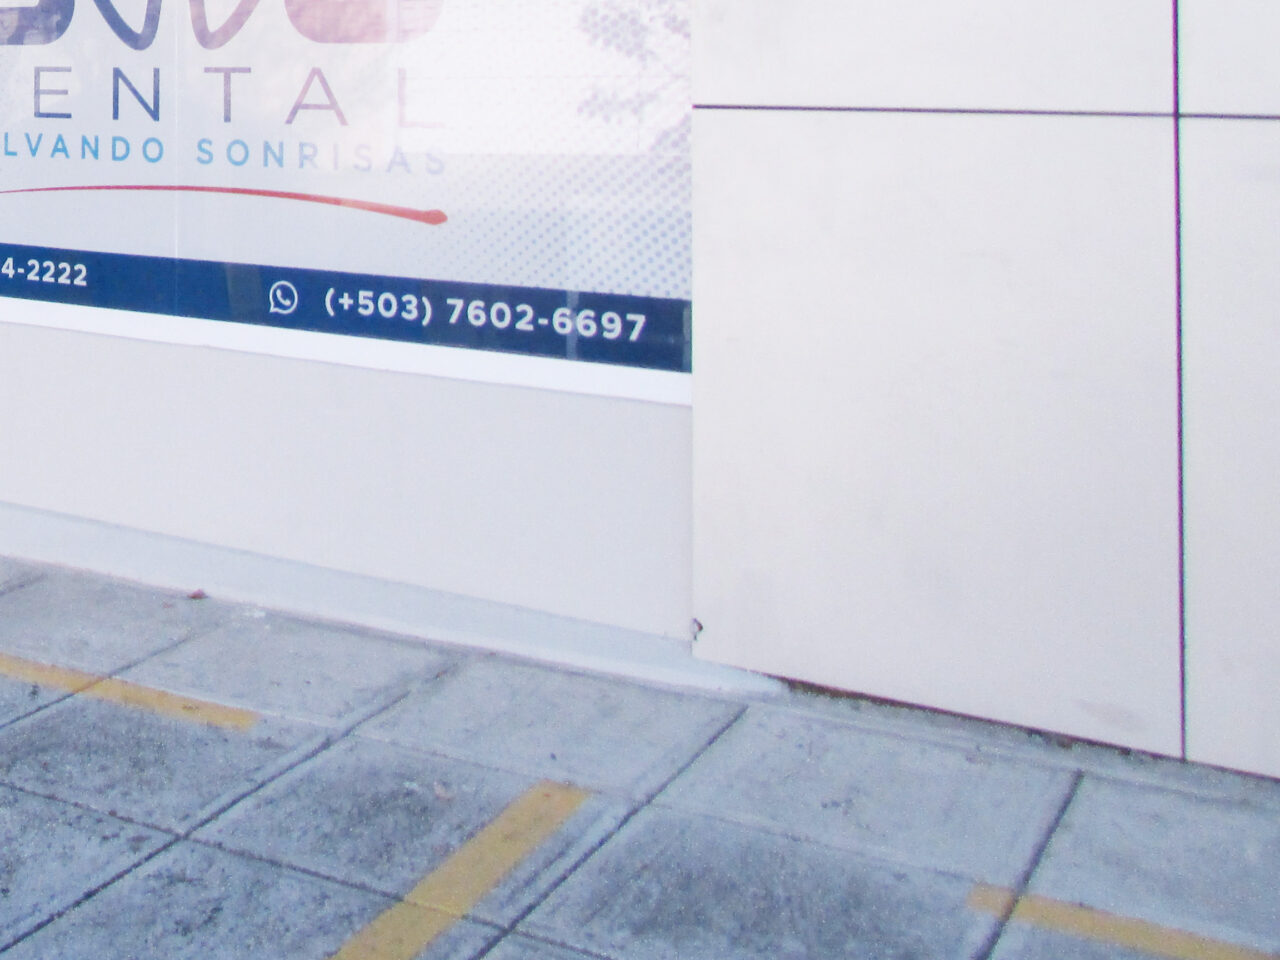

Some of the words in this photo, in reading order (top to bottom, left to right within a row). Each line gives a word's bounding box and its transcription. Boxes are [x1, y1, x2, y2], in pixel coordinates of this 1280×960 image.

[196, 139, 445, 175] SONRISAS
[324, 287, 433, 327] (+503)
[445, 297, 647, 342] 7602-6697
